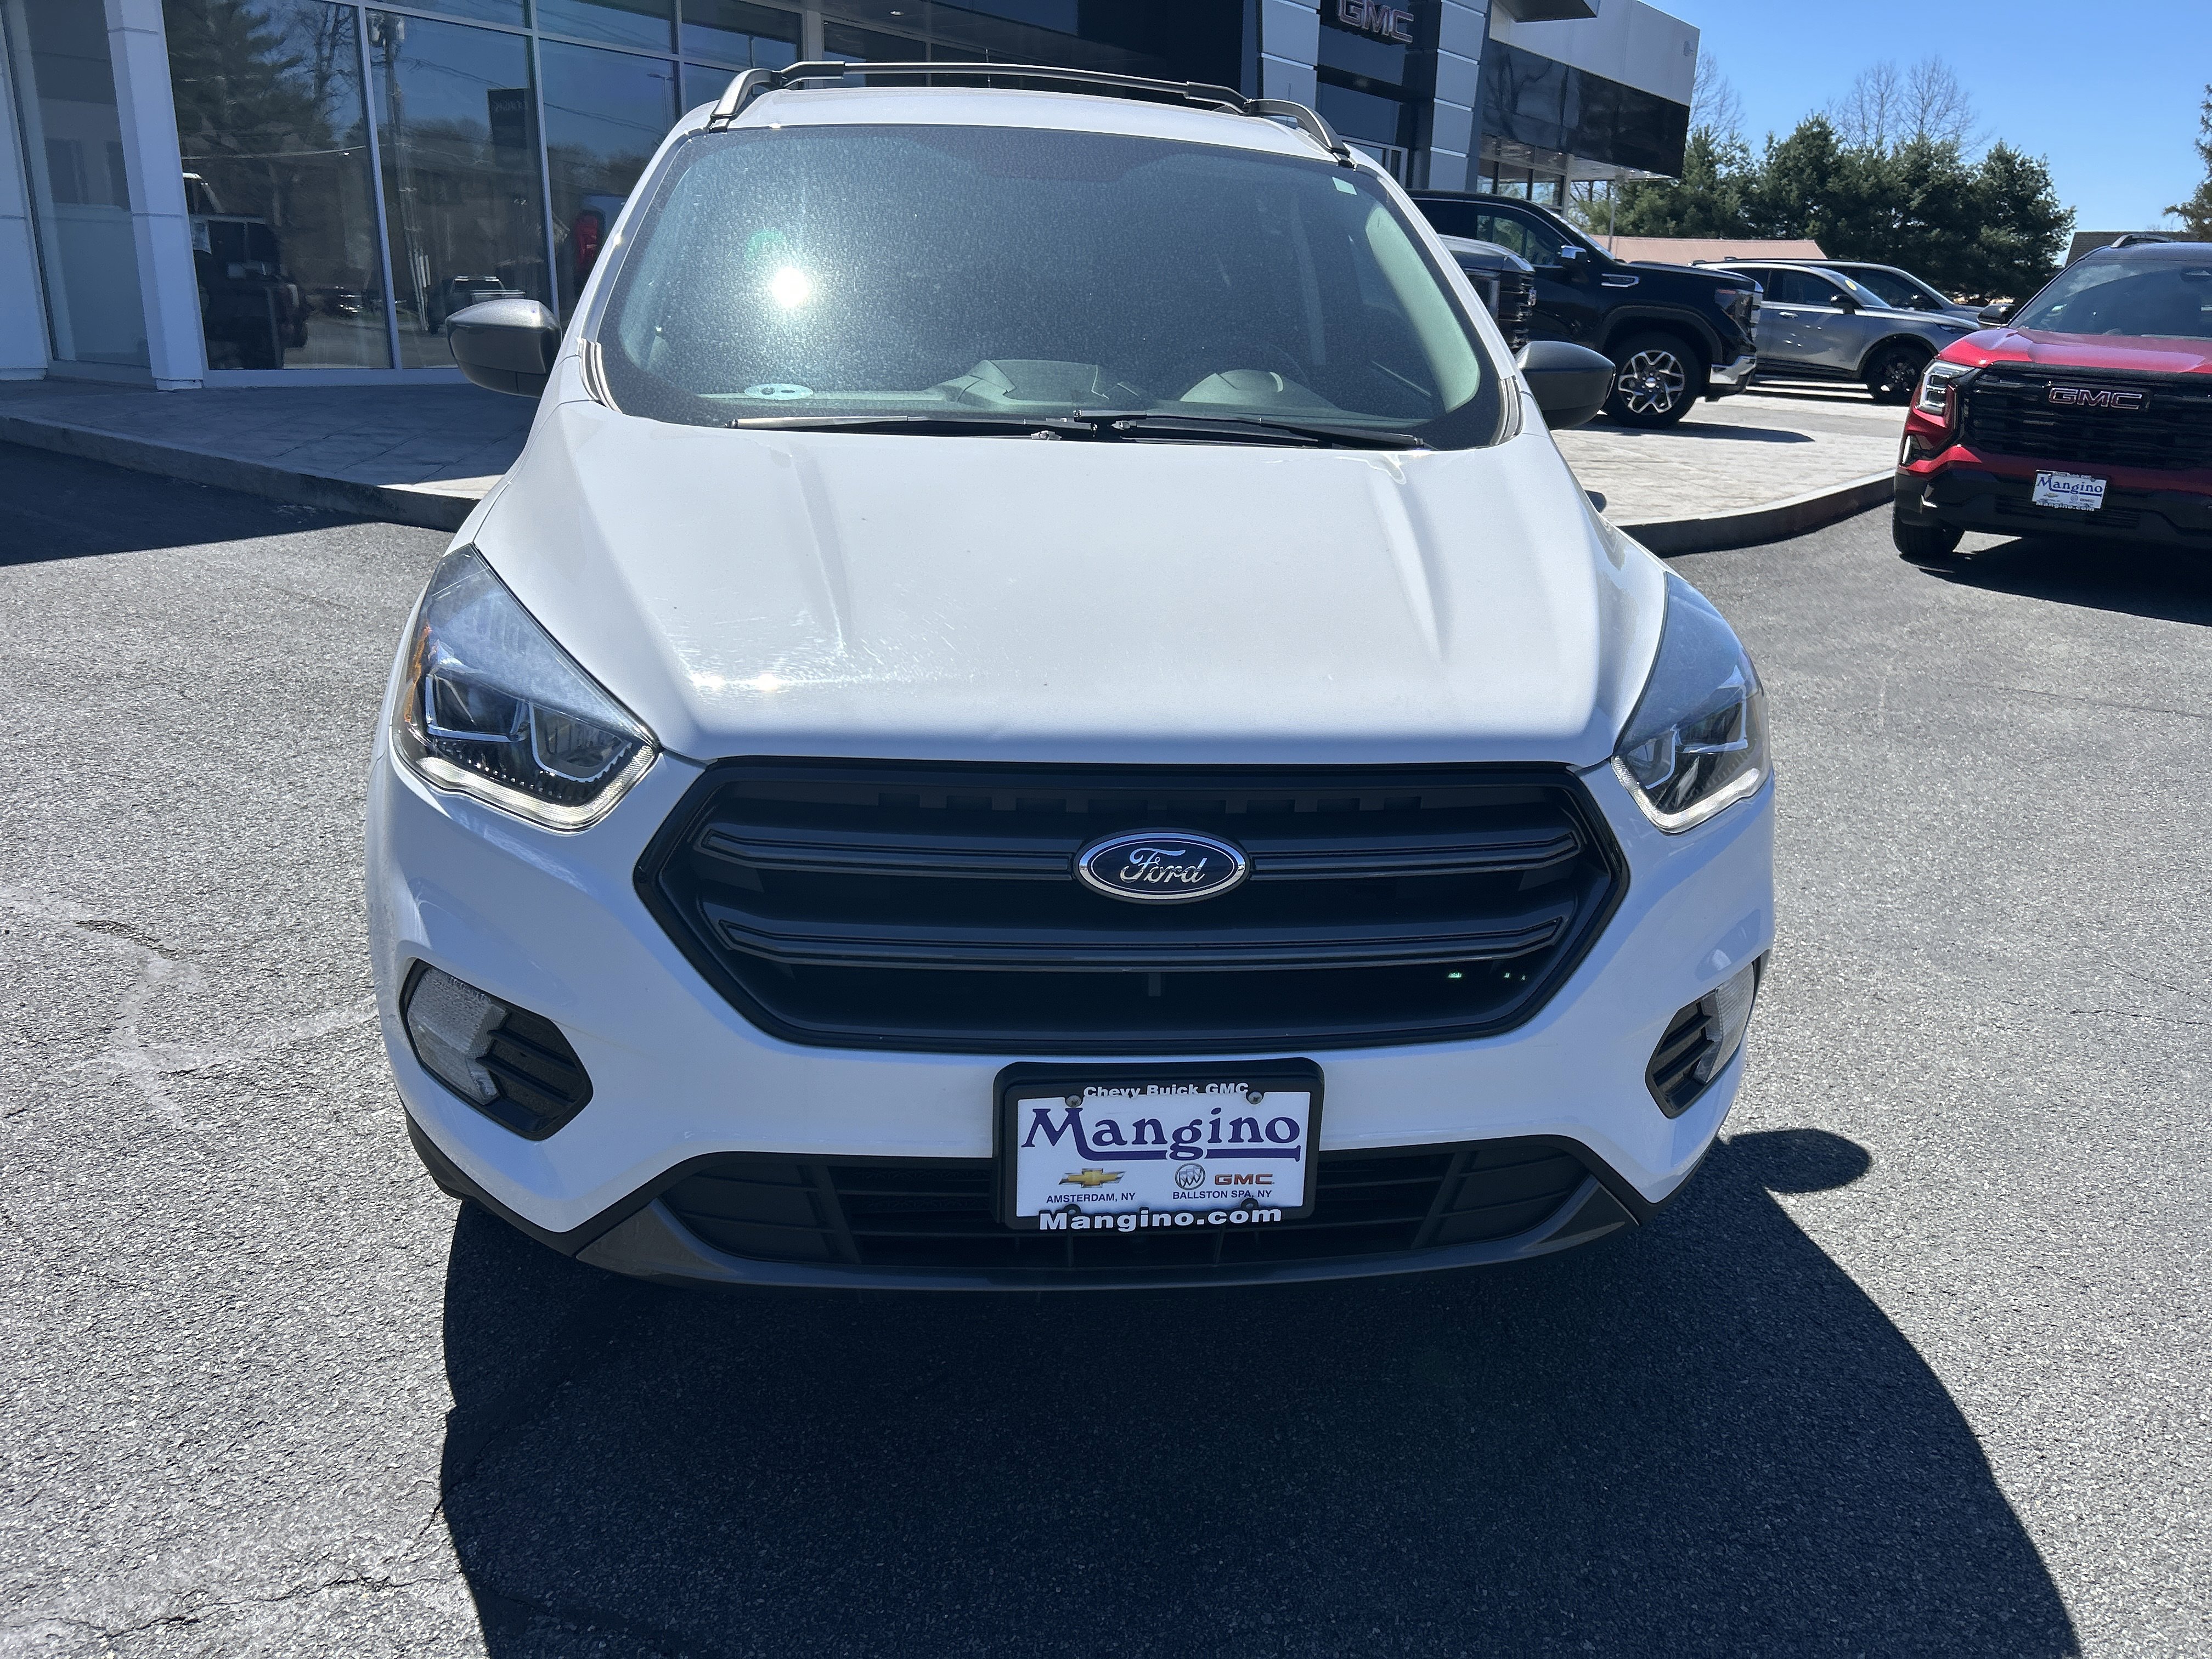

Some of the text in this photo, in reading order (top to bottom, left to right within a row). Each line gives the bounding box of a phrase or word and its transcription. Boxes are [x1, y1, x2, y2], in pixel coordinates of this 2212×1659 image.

[1339, 0, 1414, 43] GMC
[2049, 388, 2142, 410] GMC
[2037, 477, 2103, 497] Mangino
[1120, 848, 1207, 883] Ford
[1084, 1082, 1249, 1099] Chevy Buick GMC
[1021, 1107, 1301, 1161] Mangino
[1214, 1173, 1273, 1185] GMC
[1046, 1192, 1136, 1203] AMSTERDAM, NY
[1172, 1190, 1272, 1200] BALLSTON SPA, NY
[1040, 1208, 1282, 1232] Mangino.com
